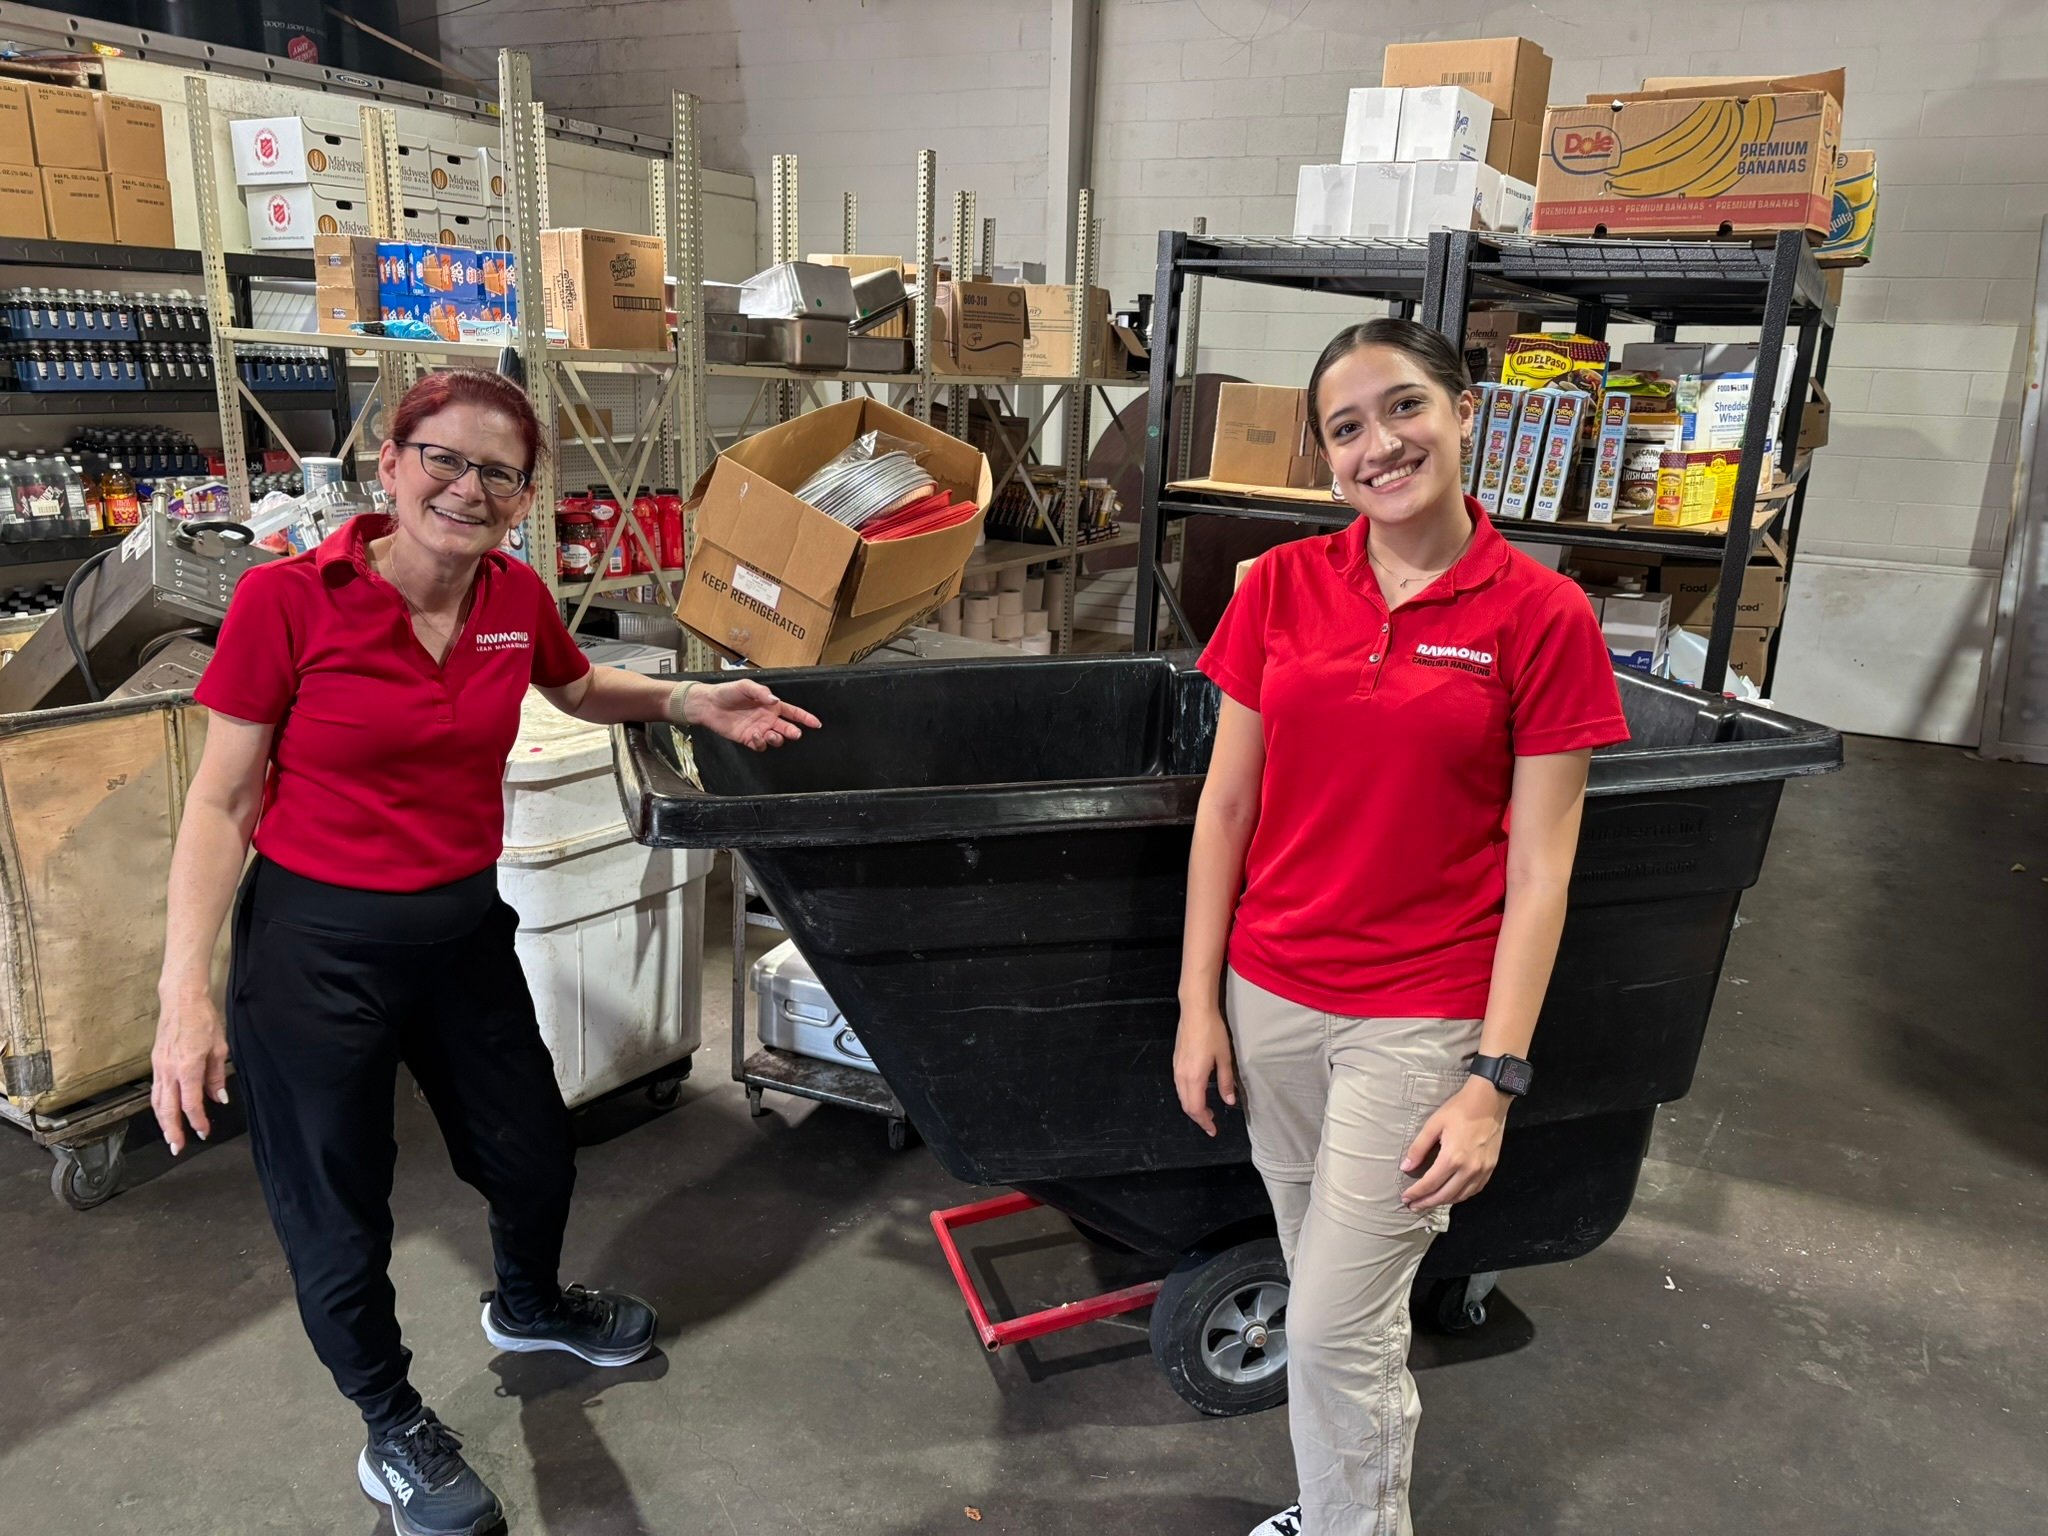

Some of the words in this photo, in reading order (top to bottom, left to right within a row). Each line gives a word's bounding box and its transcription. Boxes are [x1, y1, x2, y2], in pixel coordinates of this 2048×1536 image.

[1564, 131, 1615, 154] Dole
[1740, 141, 1808, 158] PREMIUM
[1737, 158, 1806, 175] BANANAS
[448, 174, 480, 186] Midwest
[1540, 206, 1576, 216] PREMIUM
[1577, 205, 1615, 214] BANANAS
[1625, 204, 1663, 213] PREMIUM
[1664, 202, 1705, 212] BANANAS
[1715, 200, 1757, 210] PREMIUM
[1758, 199, 1800, 208] BANANAS
[338, 220, 369, 232] Midwe
[1829, 210, 1854, 234] quita
[404, 227, 438, 240] Midwest
[457, 234, 488, 245] Midwest
[1465, 328, 1498, 341] Splenda
[1516, 355, 1533, 366] OLD
[1534, 354, 1545, 364] EL
[1506, 377, 1526, 386] KIT
[1717, 384, 1730, 392] FOOD
[1737, 384, 1748, 392] LION
[1720, 413, 1744, 423] Wheat
[1623, 469, 1640, 481] IRISH
[1680, 584, 1708, 593] Food
[701, 570, 728, 593] KEEP
[730, 588, 806, 640] REFRIGERATED
[476, 631, 529, 644] RAYMOND
[476, 644, 493, 652] LEAN
[1416, 643, 1493, 664] RAYMOND
[1412, 656, 1448, 668] CAROLINA
[1450, 659, 1490, 677] HANDLING
[381, 1460, 414, 1508] HOKA
